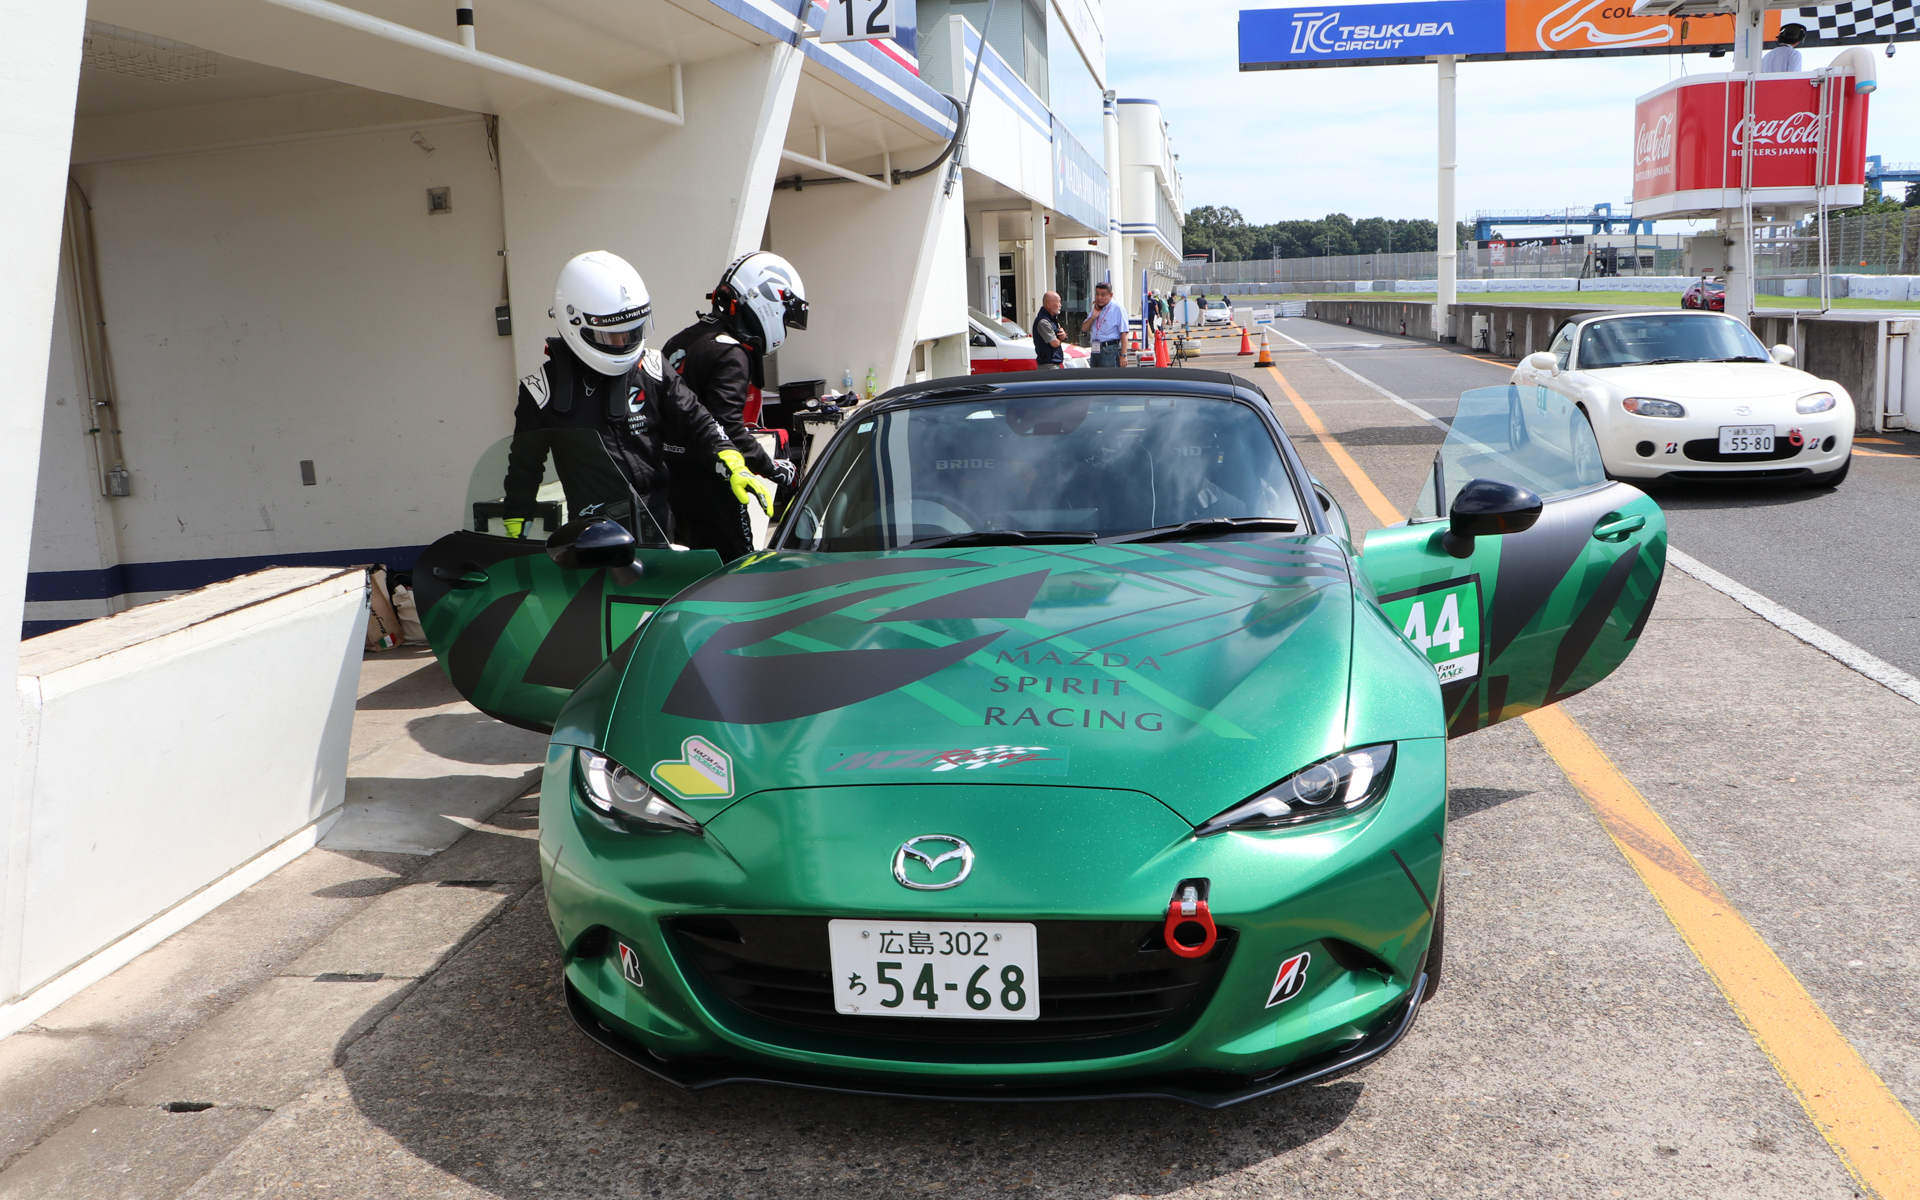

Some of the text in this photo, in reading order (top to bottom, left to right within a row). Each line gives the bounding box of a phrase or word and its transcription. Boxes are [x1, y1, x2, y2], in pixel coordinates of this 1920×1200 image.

[839, 0, 889, 36] 12
[1339, 22, 1455, 39] TSUKUBA
[1778, 147, 1807, 156] JAPAN
[602, 315, 624, 324] MAZDA
[625, 310, 641, 319] SPIRIT
[1731, 436, 1771, 451] 55-80
[935, 458, 995, 470] BRIDE
[1403, 593, 1464, 656] 44
[995, 650, 1162, 671] MAZDA
[1438, 664, 1455, 672] Fan
[990, 676, 1128, 696] SPIRIT
[984, 706, 1163, 732] RACING
[876, 961, 1027, 1012] 54-68
